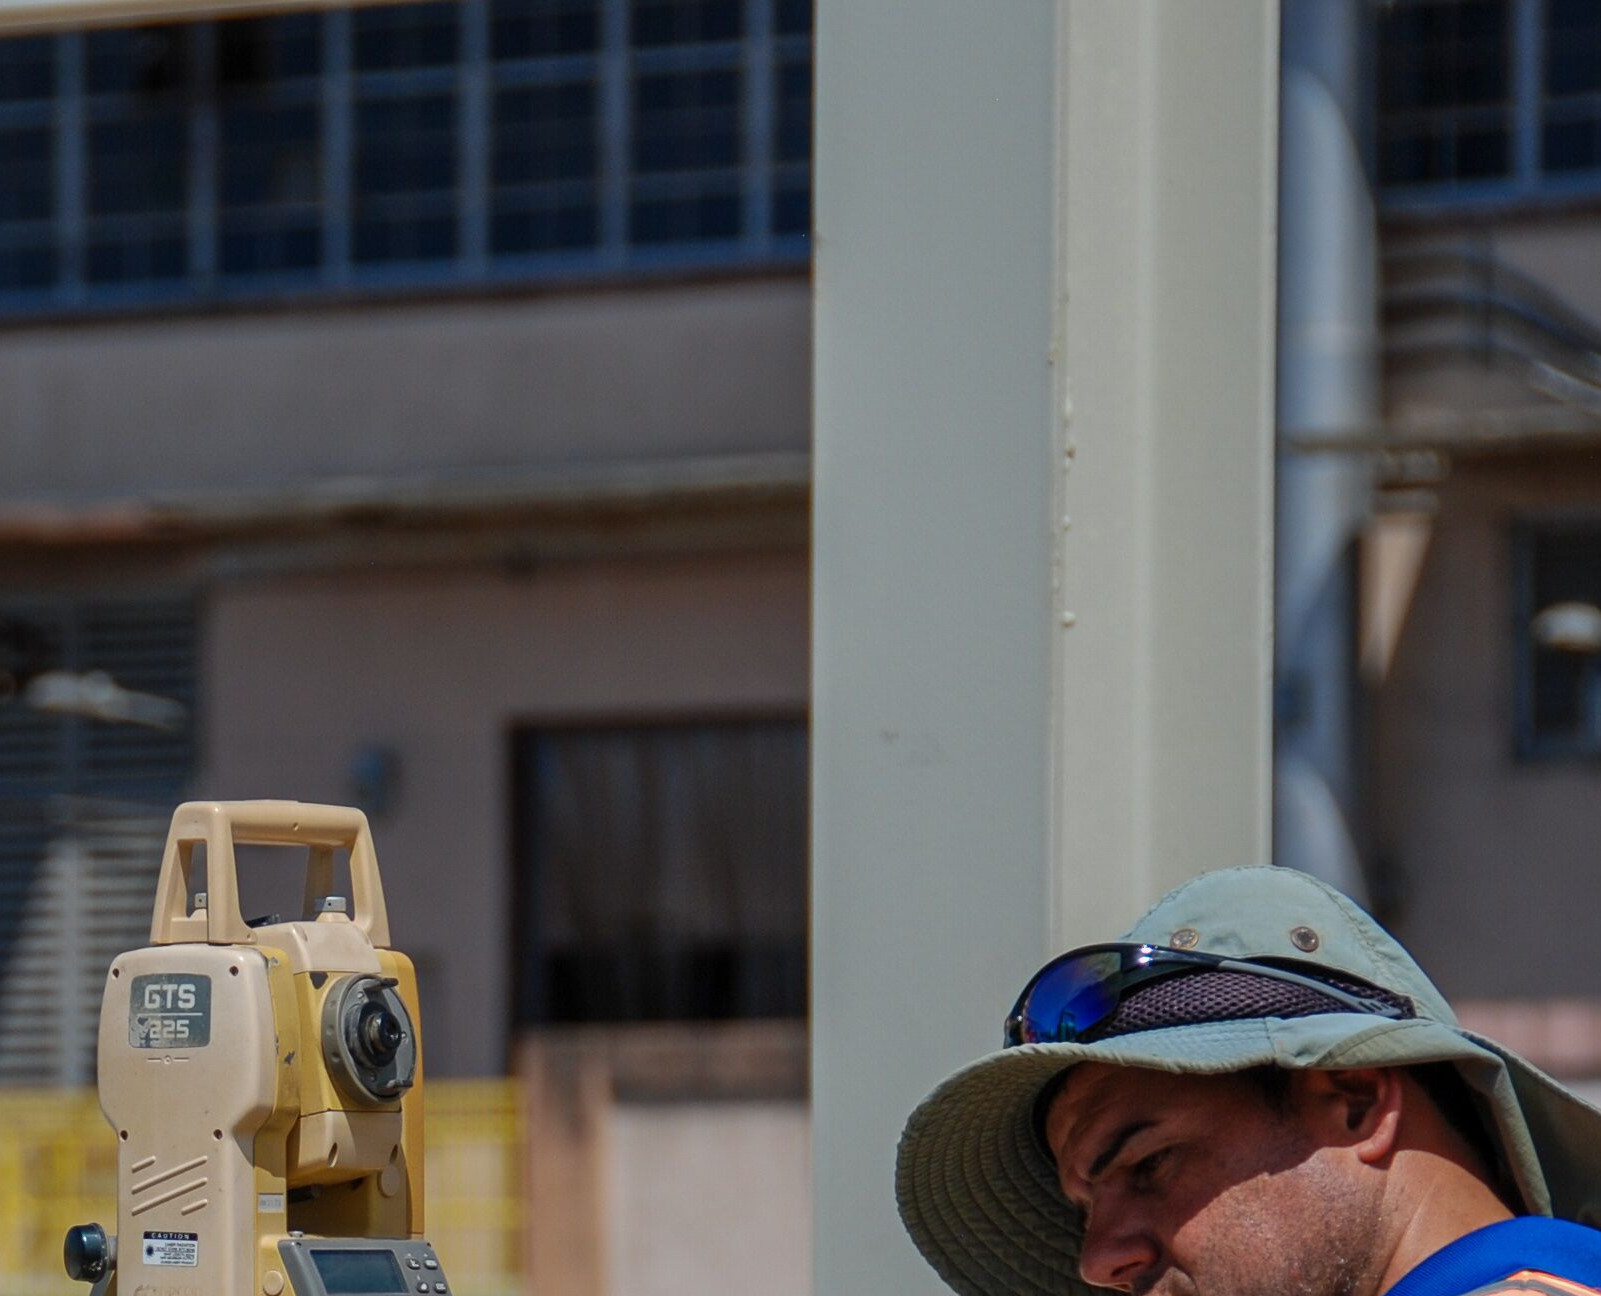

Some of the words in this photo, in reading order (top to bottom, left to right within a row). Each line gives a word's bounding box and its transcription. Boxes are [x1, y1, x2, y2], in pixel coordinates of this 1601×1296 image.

[144, 983, 196, 1009] GTS
[149, 1019, 190, 1039] 225
[151, 1232, 190, 1240] CAUTION
